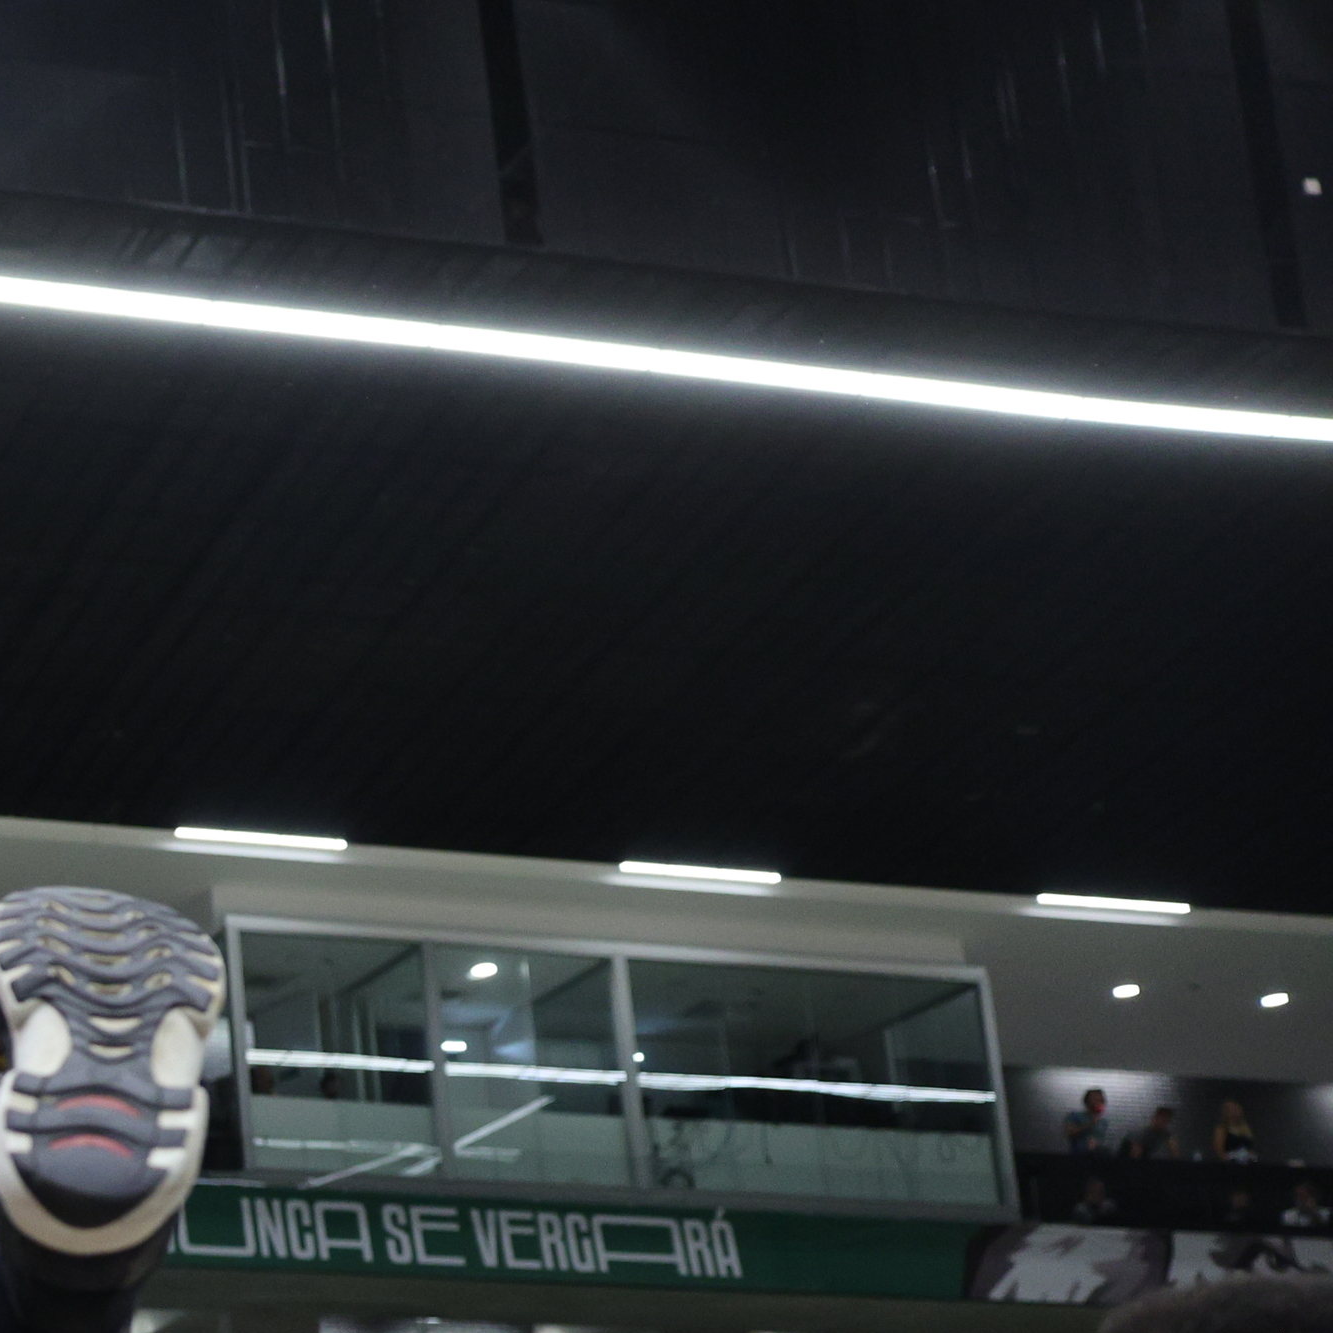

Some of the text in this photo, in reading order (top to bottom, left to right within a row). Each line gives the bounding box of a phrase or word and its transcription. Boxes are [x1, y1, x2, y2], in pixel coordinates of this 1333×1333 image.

[167, 1195, 374, 1264] UNCA
[382, 1203, 466, 1267] SE
[470, 1206, 743, 1279] VERGARÁ
